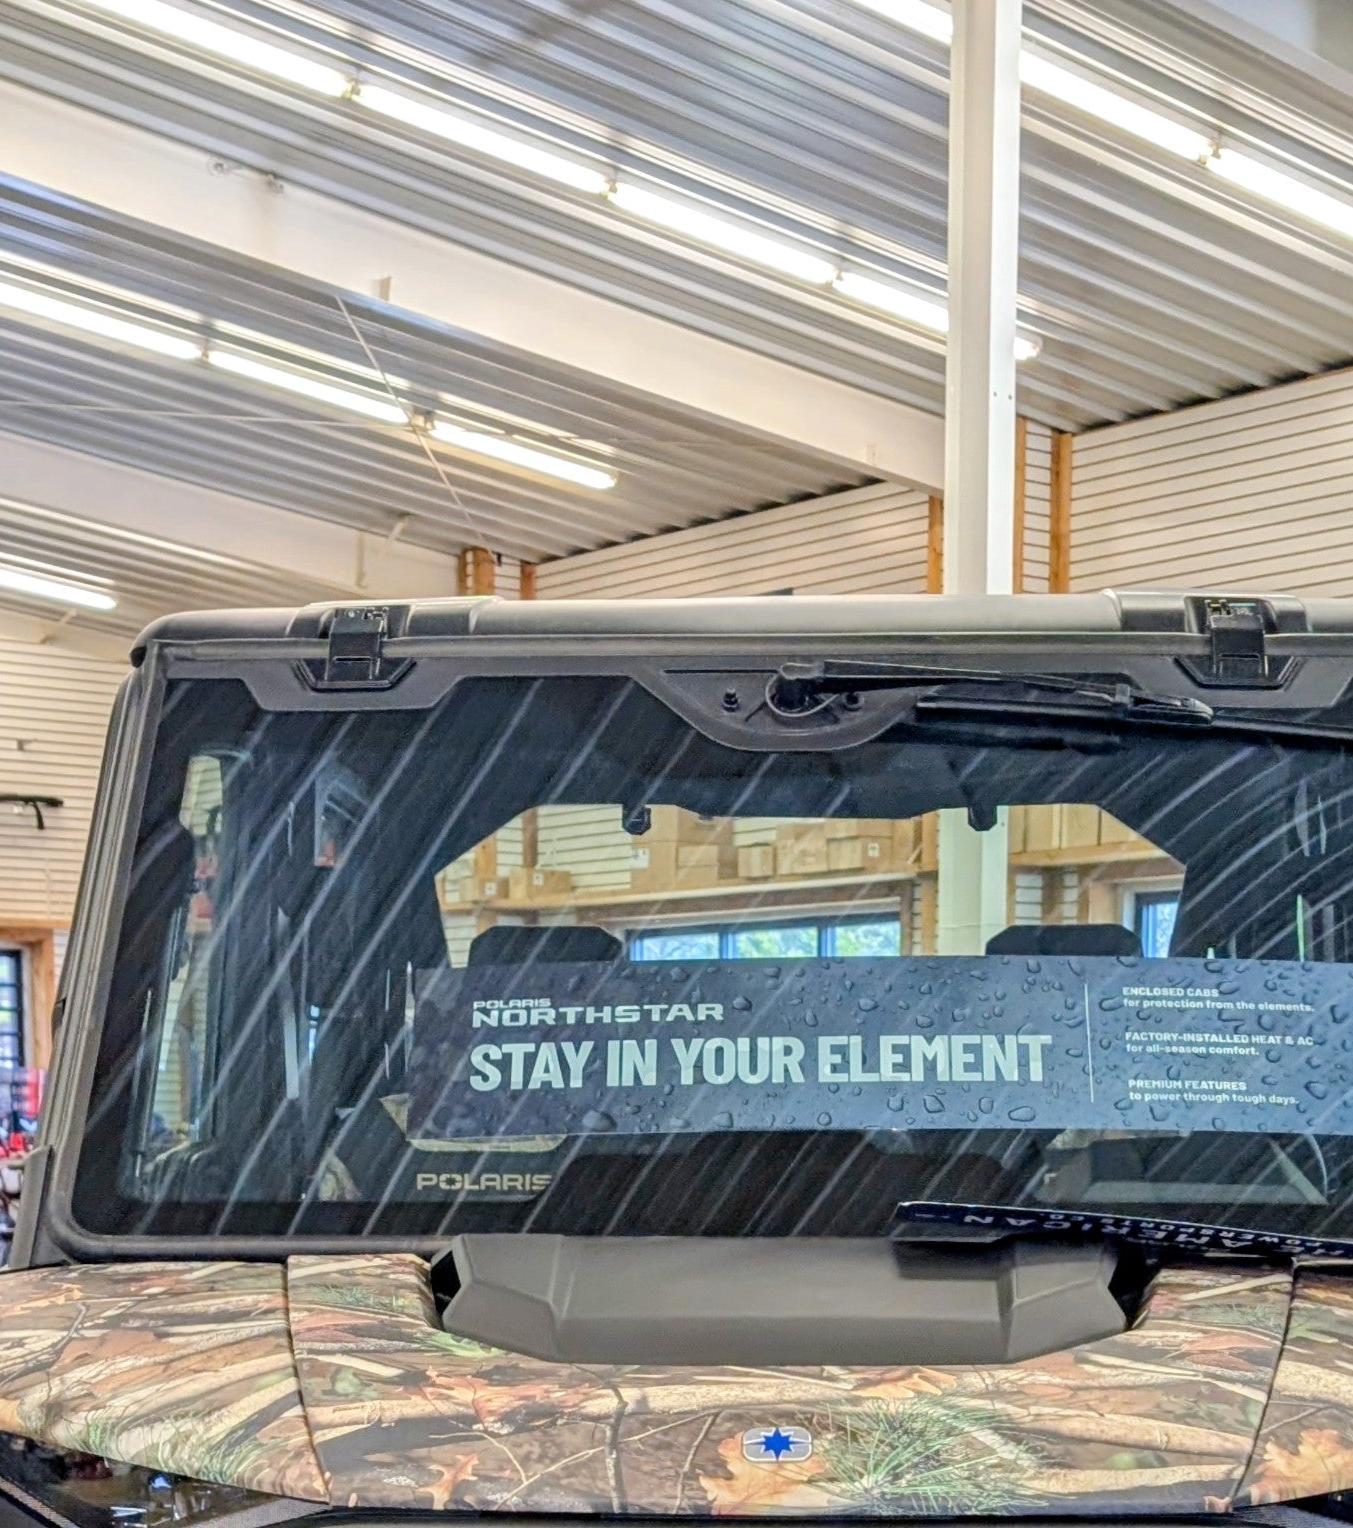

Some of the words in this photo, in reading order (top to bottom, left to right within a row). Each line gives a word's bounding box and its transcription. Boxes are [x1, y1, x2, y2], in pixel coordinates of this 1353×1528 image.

[1122, 986, 1184, 997] ENCLOSED
[1186, 988, 1219, 998] CABS
[473, 997, 552, 1010] POLARIS
[1123, 998, 1139, 1007] for
[1143, 999, 1204, 1011] protection
[1206, 1000, 1234, 1009] from
[1236, 1001, 1255, 1010] the
[1258, 1002, 1315, 1012] elements.
[472, 1003, 725, 1028] NORTHSTAR
[1125, 1032, 1248, 1044] FACTORY-INSTALLED
[1251, 1034, 1282, 1045] HEAT
[1285, 1036, 1294, 1045] &
[1297, 1036, 1314, 1046] AC
[1126, 1043, 1143, 1052] for
[1146, 1044, 1207, 1054] all-season
[1209, 1045, 1259, 1055] comfort.
[469, 1040, 595, 1091] STAY
[606, 1039, 657, 1087] IN
[670, 1036, 805, 1086] YOUR
[818, 1034, 1052, 1083] ELEMENT
[1128, 1079, 1182, 1089] PREMIUM
[1184, 1080, 1247, 1090] FEATURES
[1129, 1091, 1141, 1100] to
[1145, 1093, 1181, 1103] power
[1183, 1092, 1230, 1104] through
[1232, 1093, 1266, 1105] tough
[1269, 1094, 1299, 1106] days.
[416, 1173, 553, 1191] POLARIS
